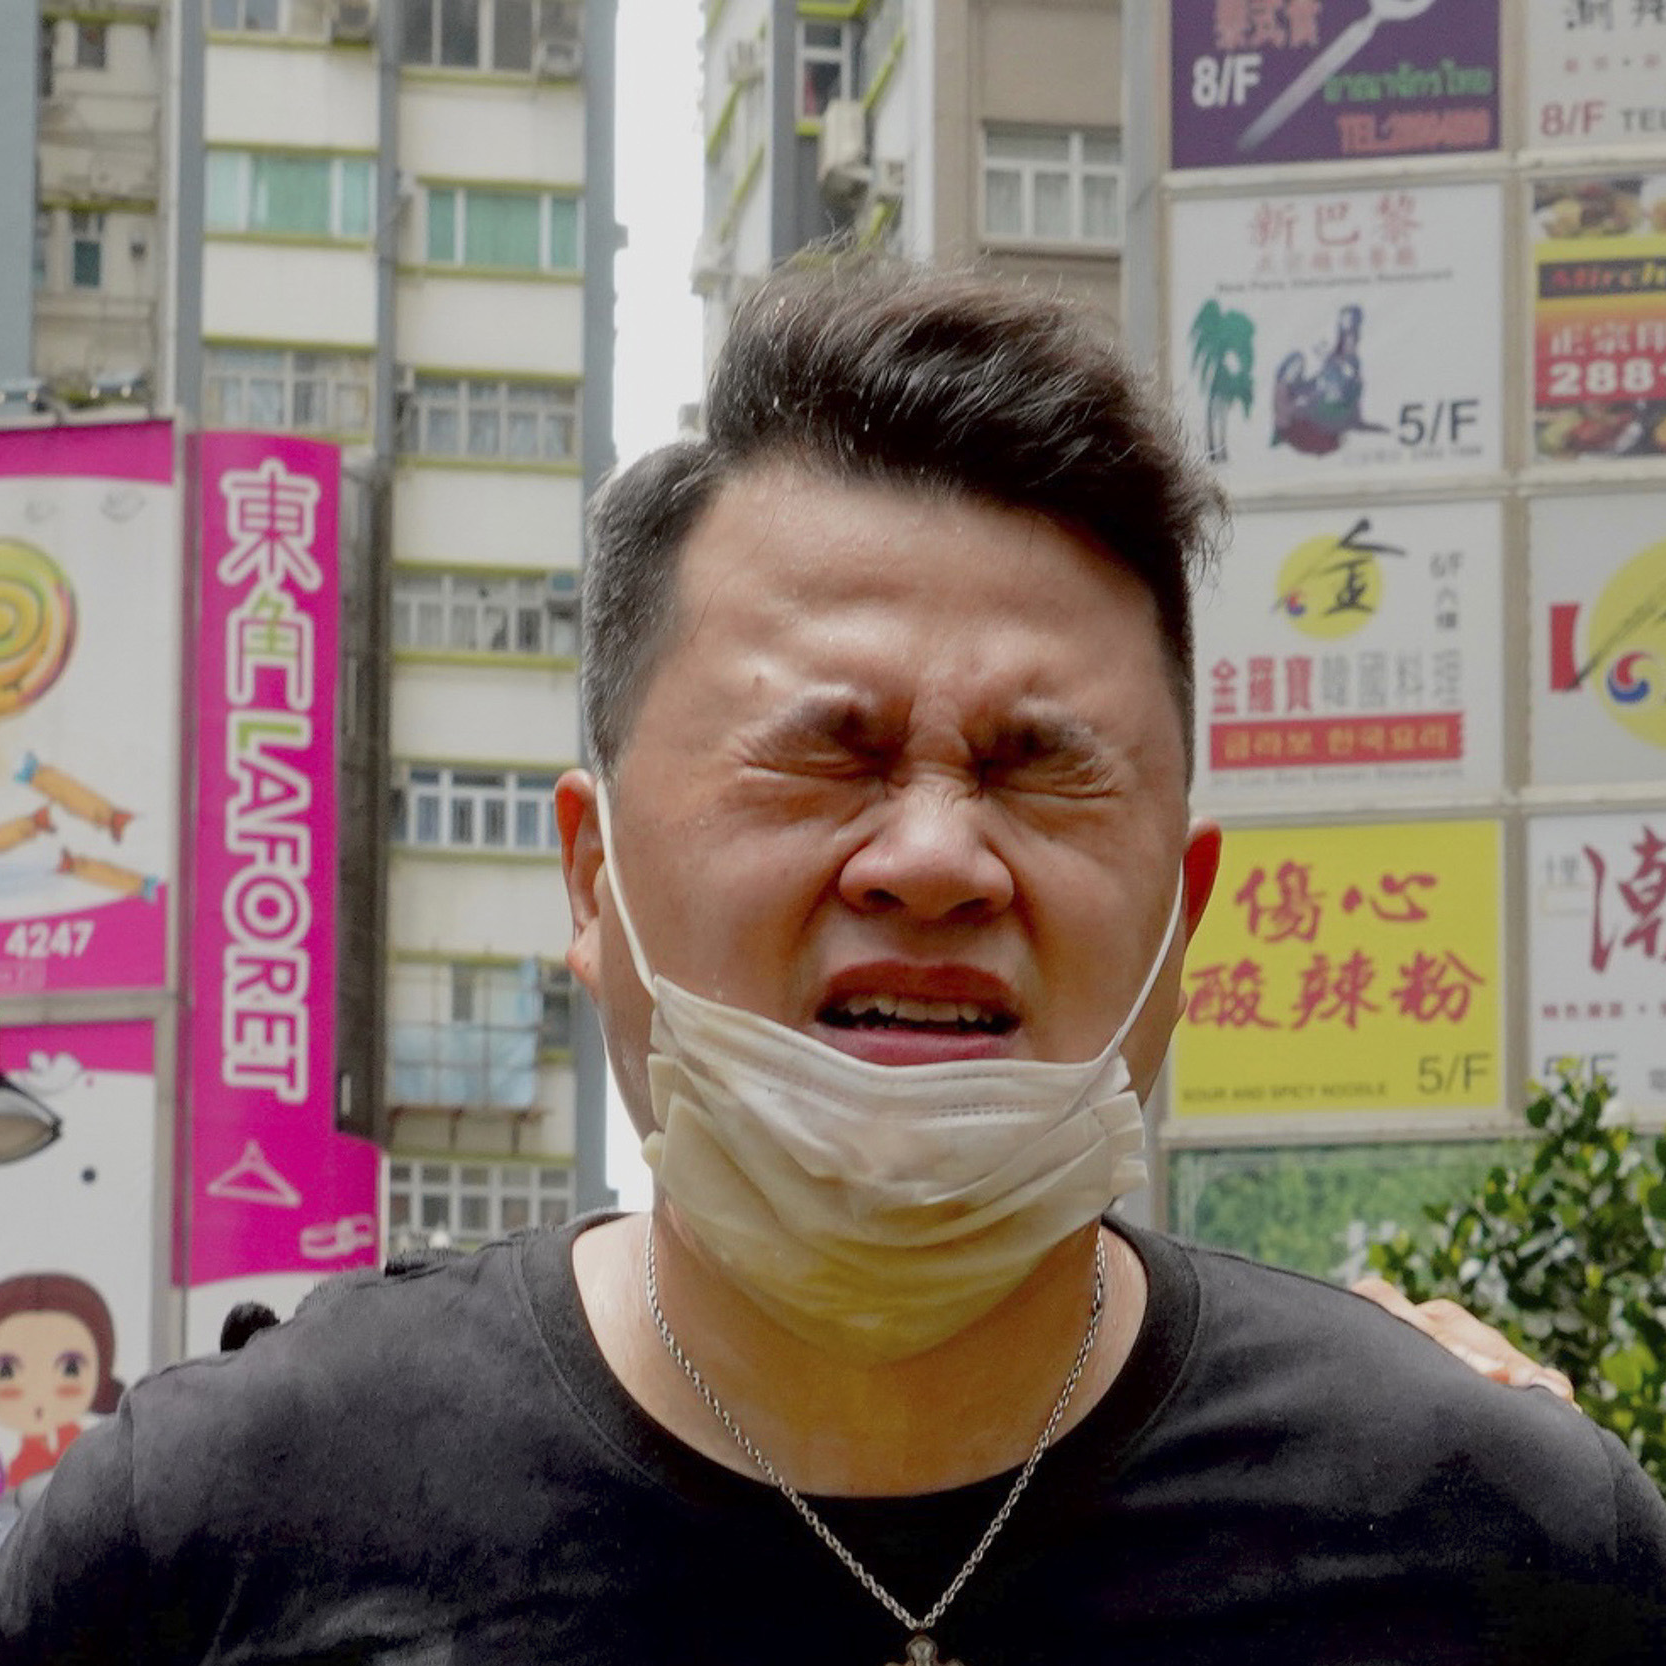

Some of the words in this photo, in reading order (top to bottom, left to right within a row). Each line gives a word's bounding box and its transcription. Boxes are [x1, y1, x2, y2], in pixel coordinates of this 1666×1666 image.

[1191, 54, 1262, 107] 8/F
[1539, 100, 1605, 136] 8/F
[1398, 399, 1480, 445] 5/F
[1271, 516, 1407, 618] 金
[224, 708, 313, 1106] LAFORET
[1236, 861, 1439, 943] 傷心
[5, 919, 96, 959] 4247
[1187, 950, 1485, 1029] 酸辣粉
[1417, 1053, 1491, 1095] 5/F
